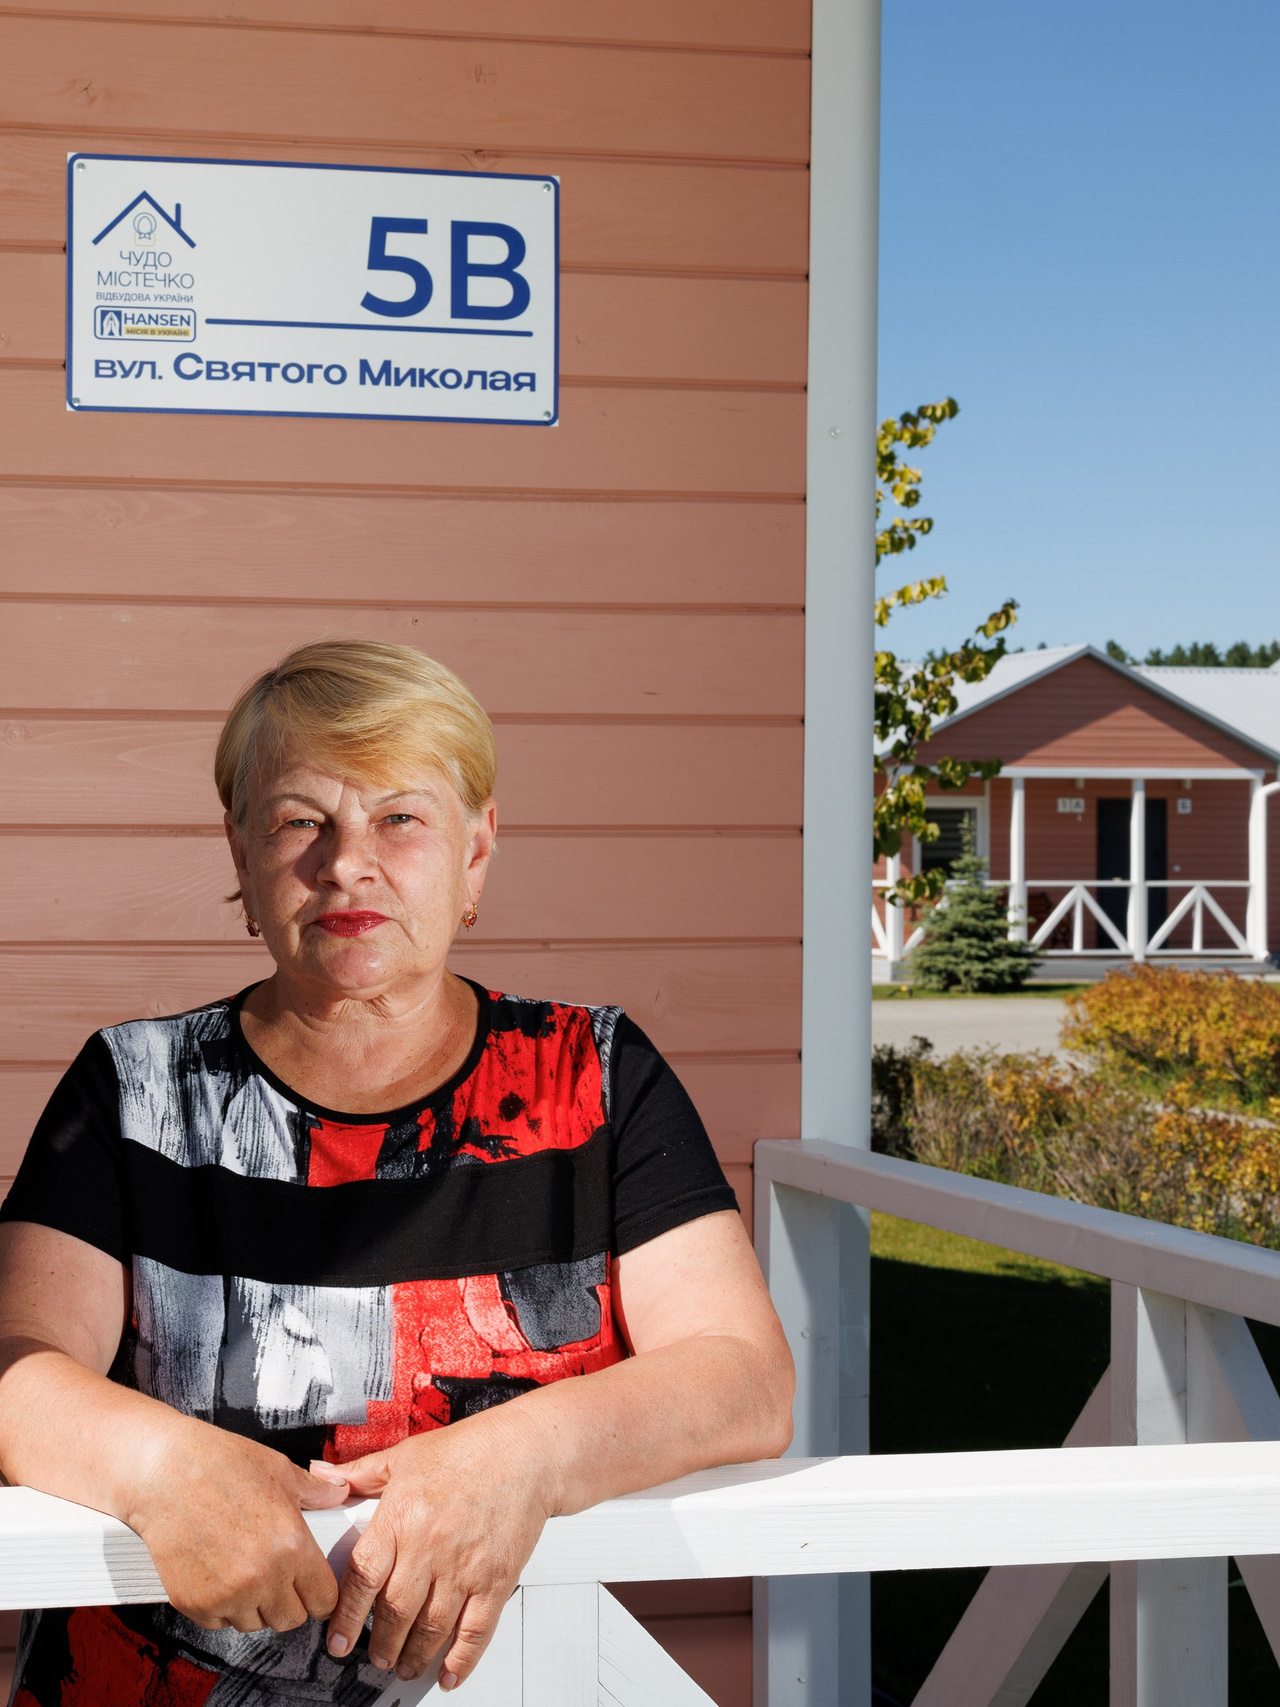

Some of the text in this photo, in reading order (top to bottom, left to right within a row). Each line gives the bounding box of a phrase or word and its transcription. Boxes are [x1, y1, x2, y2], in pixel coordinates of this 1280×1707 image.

[119, 250, 173, 271] ЧУДО
[360, 216, 531, 321] 5В
[96, 270, 195, 290] МІСТЕЧКО
[95, 291, 194, 303] ВІДБУДОВА УКРАЇНИ
[123, 312, 191, 327] HANSEN
[126, 328, 149, 336] МІСІЯ
[157, 329, 189, 337] УКРАЇНІ
[93, 351, 537, 393] вул. Святого Миколая
